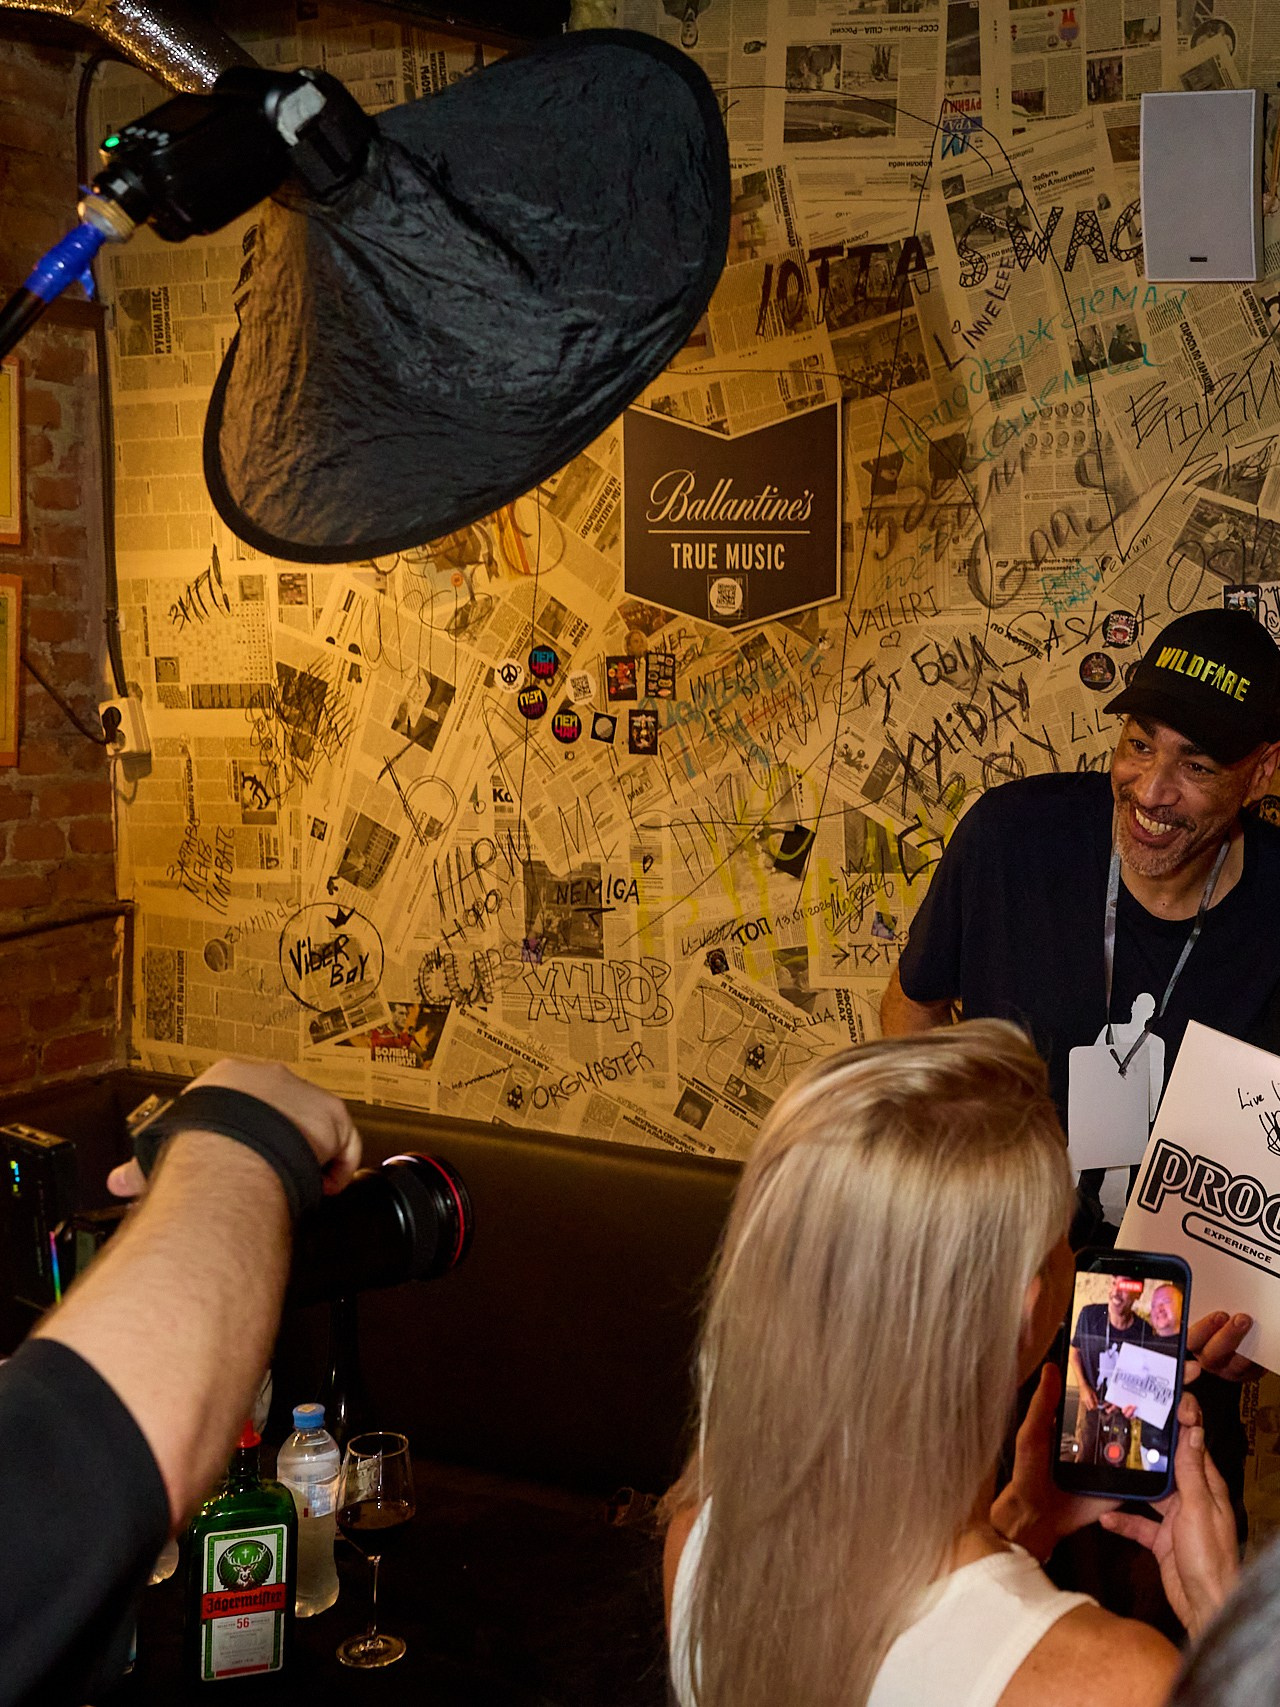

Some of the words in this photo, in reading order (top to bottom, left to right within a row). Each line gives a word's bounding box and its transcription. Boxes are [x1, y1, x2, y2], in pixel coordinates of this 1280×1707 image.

[1031, 170, 1059, 183] Забыть
[1033, 182, 1048, 191] про
[153, 314, 164, 354] РУБИМ
[1177, 321, 1200, 352] СТАРОСТЬ
[646, 468, 815, 523] Ballantine's
[671, 543, 718, 569] TRUE
[726, 543, 785, 570] MUSIC
[989, 622, 1004, 635] ПО
[911, 632, 1004, 686] БЫЛ
[1155, 646, 1251, 702] WILDFARE
[731, 916, 773, 947] ТОП
[483, 1032, 504, 1047] ТАКИ
[1203, 1226, 1272, 1264] EXPERIENCE
[236, 1617, 250, 1629] 56
